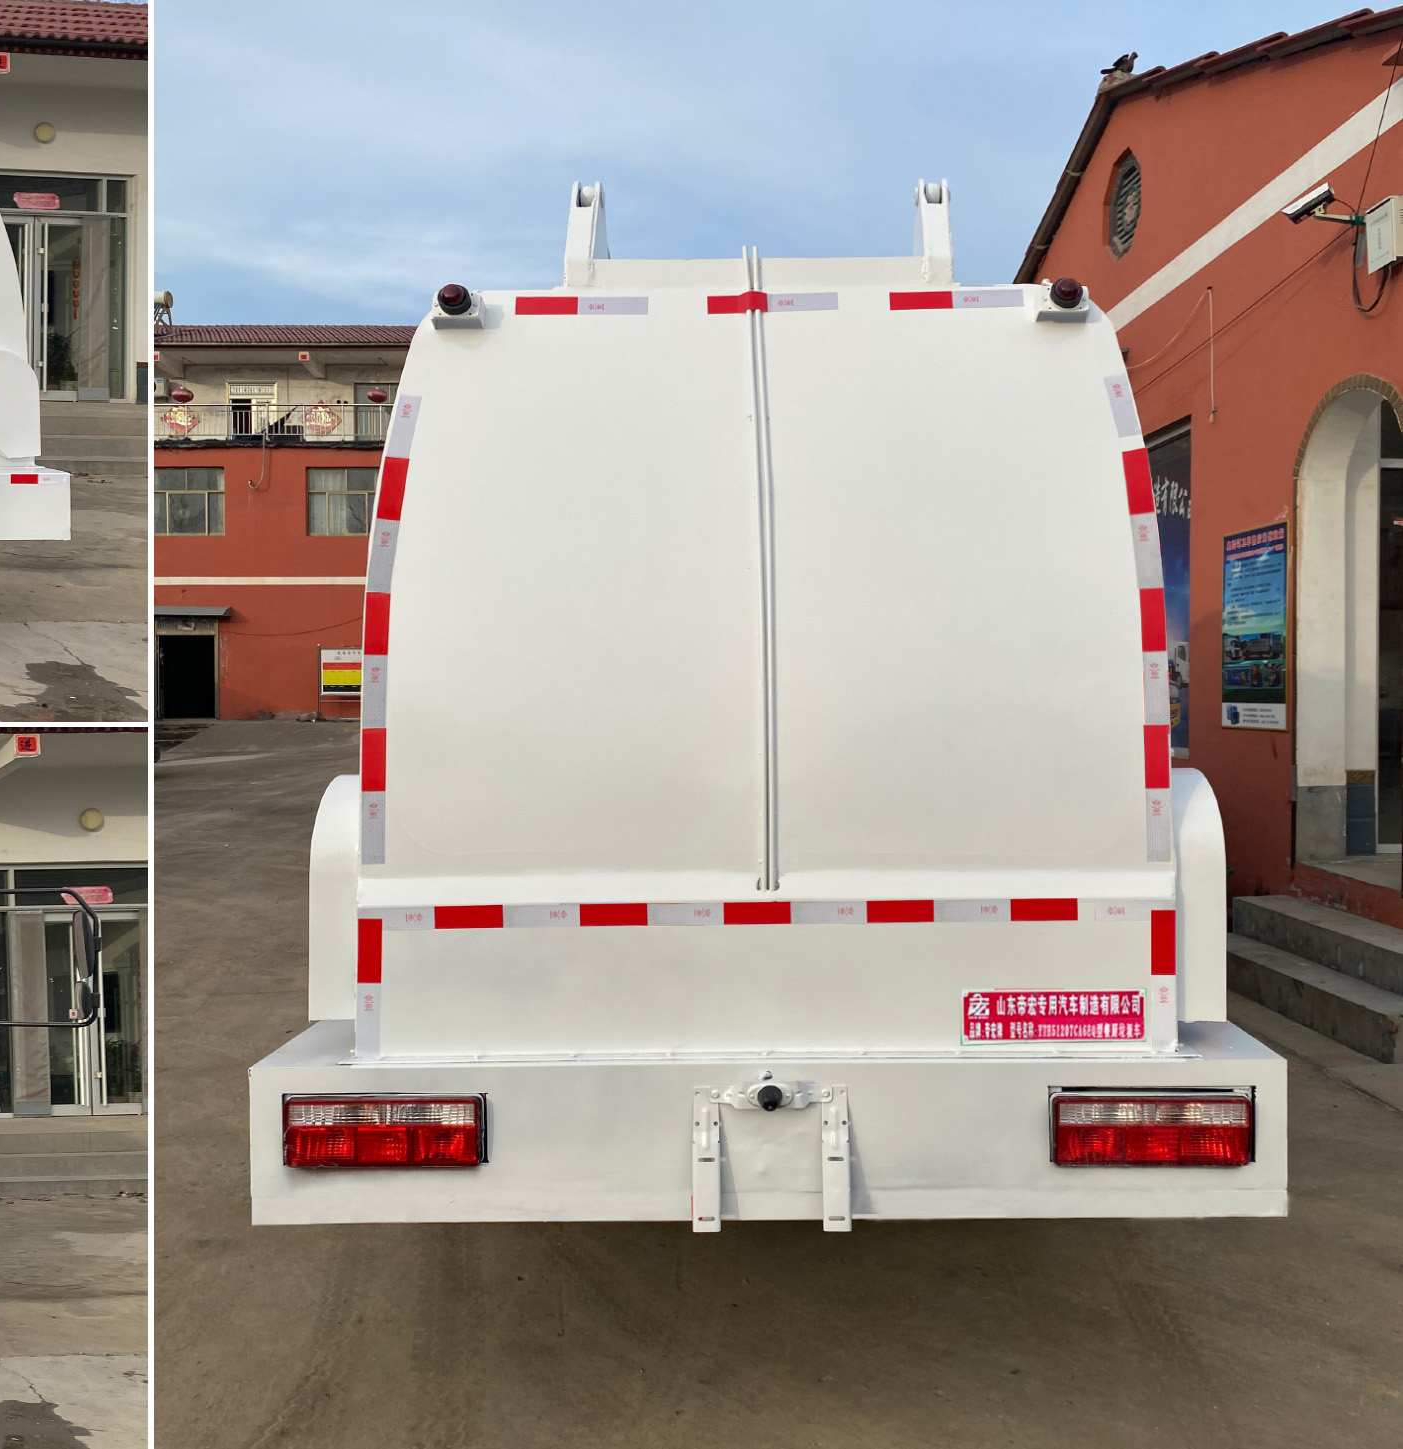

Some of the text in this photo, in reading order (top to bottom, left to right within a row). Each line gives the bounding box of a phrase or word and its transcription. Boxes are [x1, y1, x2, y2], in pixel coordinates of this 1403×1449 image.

[20, 738, 32, 752] 进
[996, 993, 1141, 1016] 山东帝宏专用汽车制造有限公司
